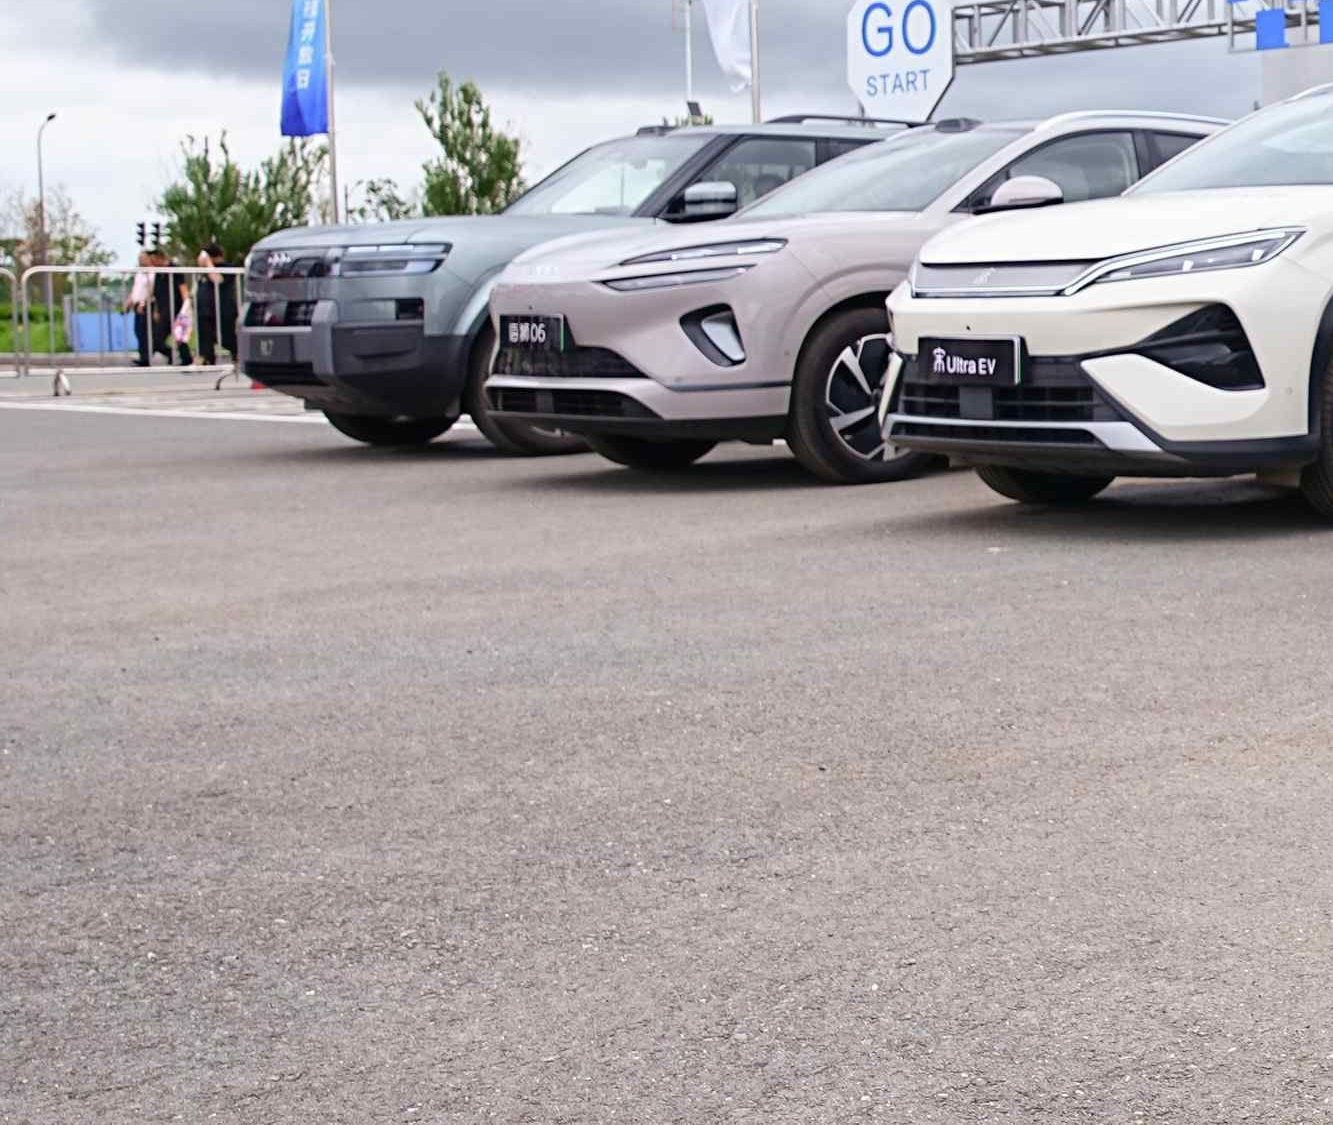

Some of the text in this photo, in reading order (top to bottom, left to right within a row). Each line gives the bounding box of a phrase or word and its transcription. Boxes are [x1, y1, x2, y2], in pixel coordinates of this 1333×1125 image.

[862, 0, 937, 58] GO
[866, 69, 931, 98] START
[946, 355, 977, 375] Ultra
[978, 358, 996, 376] EV
